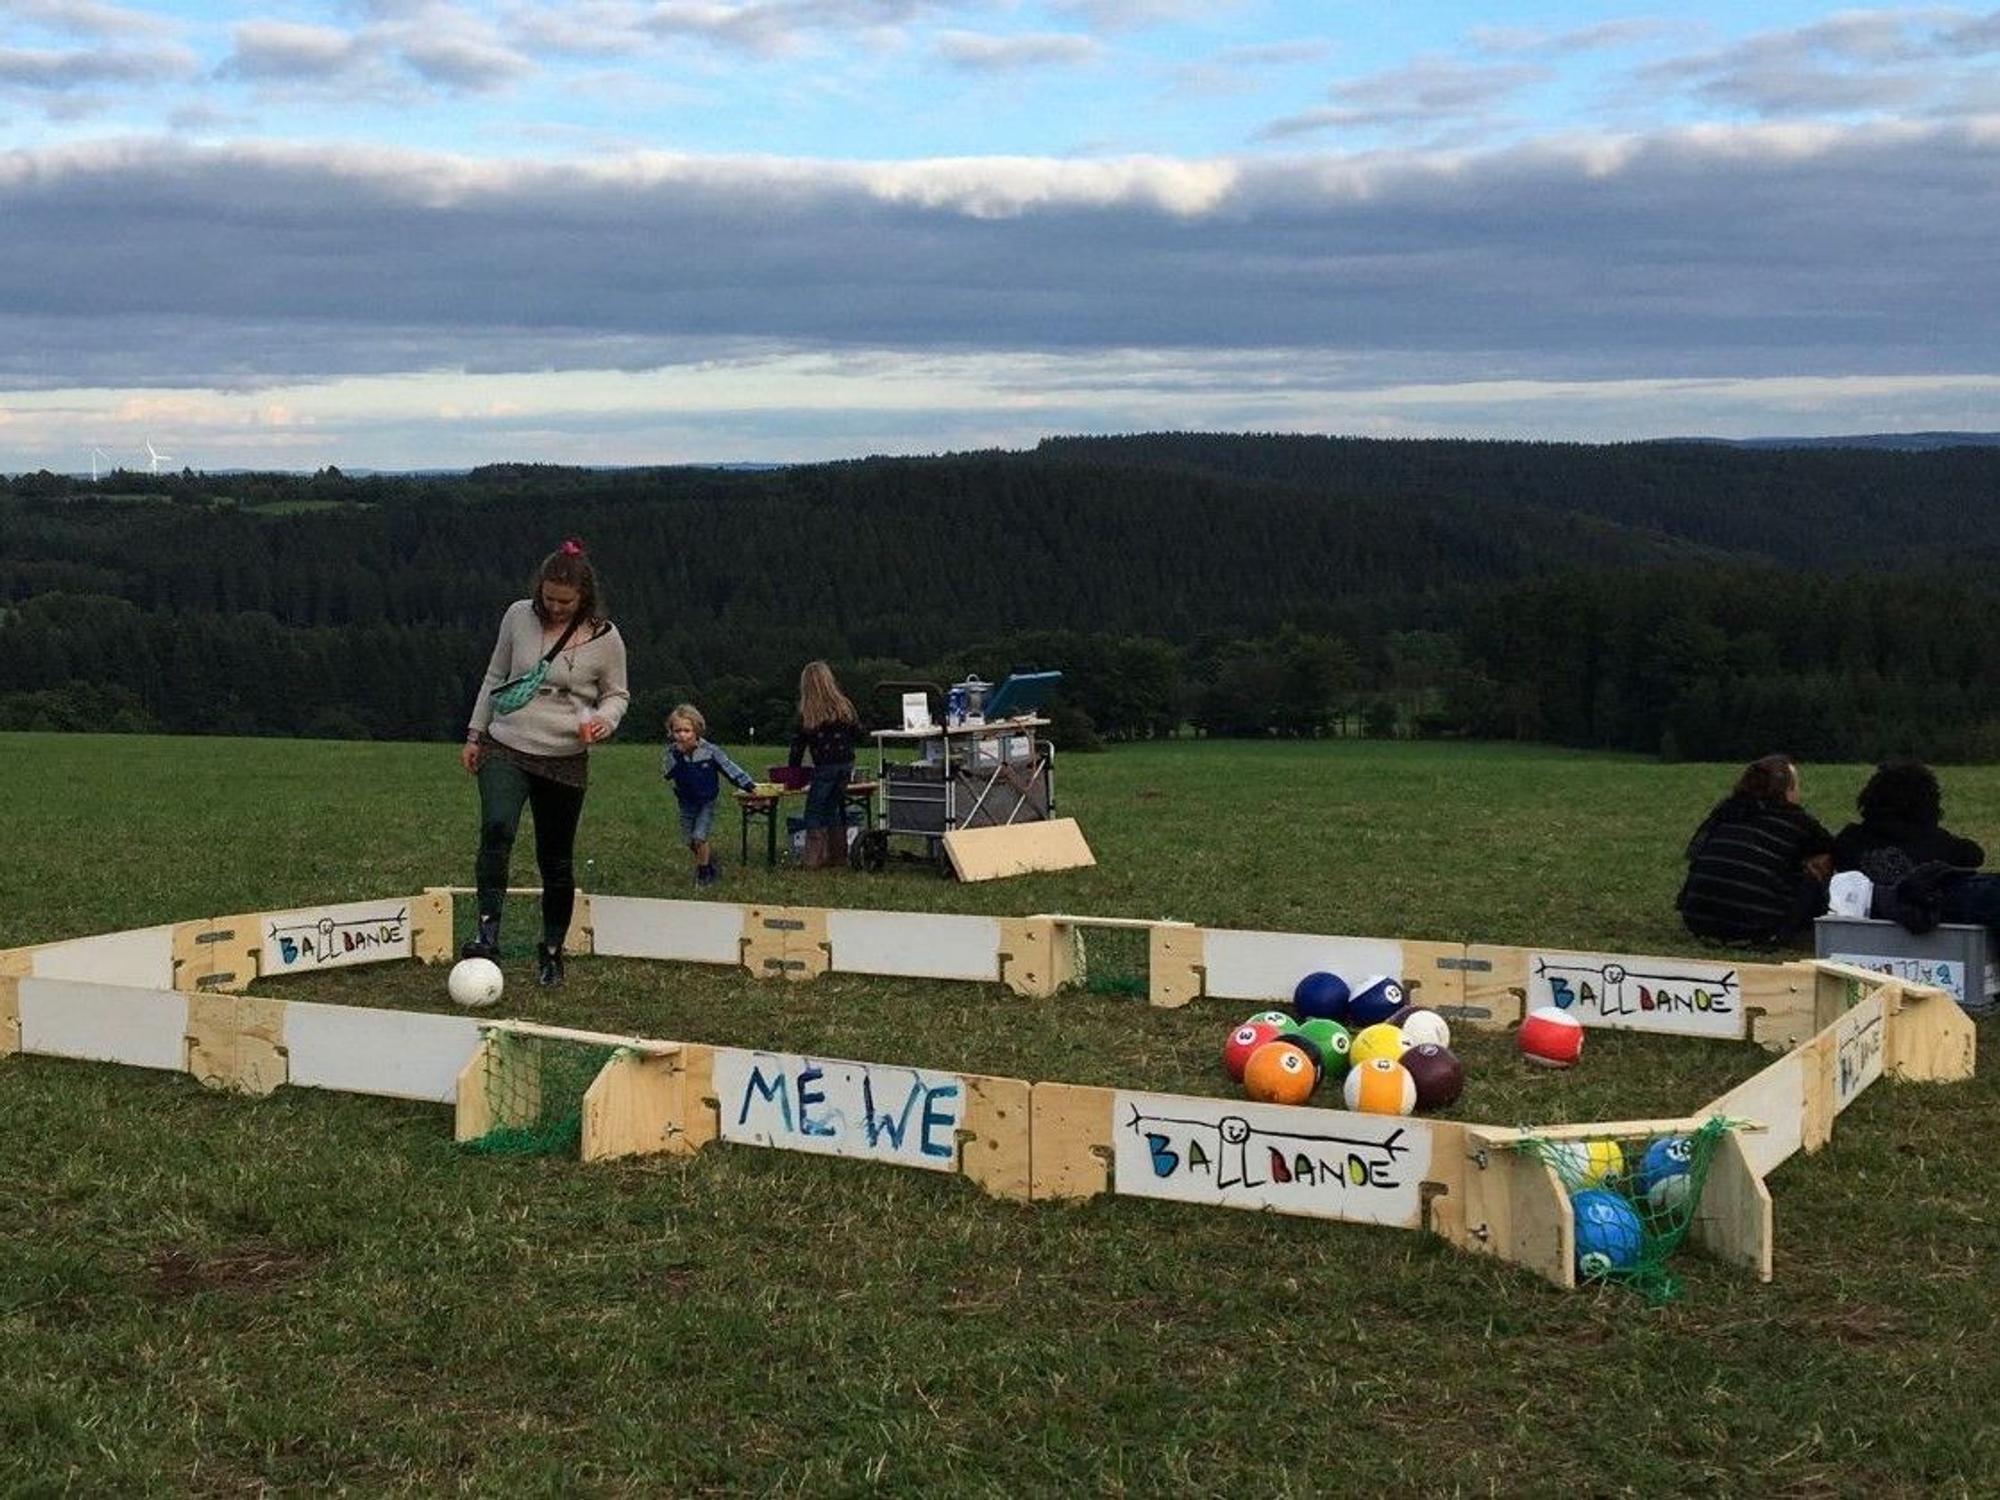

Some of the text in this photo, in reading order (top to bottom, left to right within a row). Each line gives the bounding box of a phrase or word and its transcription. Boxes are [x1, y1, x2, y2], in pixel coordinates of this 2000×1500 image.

[1285, 1055, 1300, 1070] 5
[740, 1064, 958, 1158] ME WE
